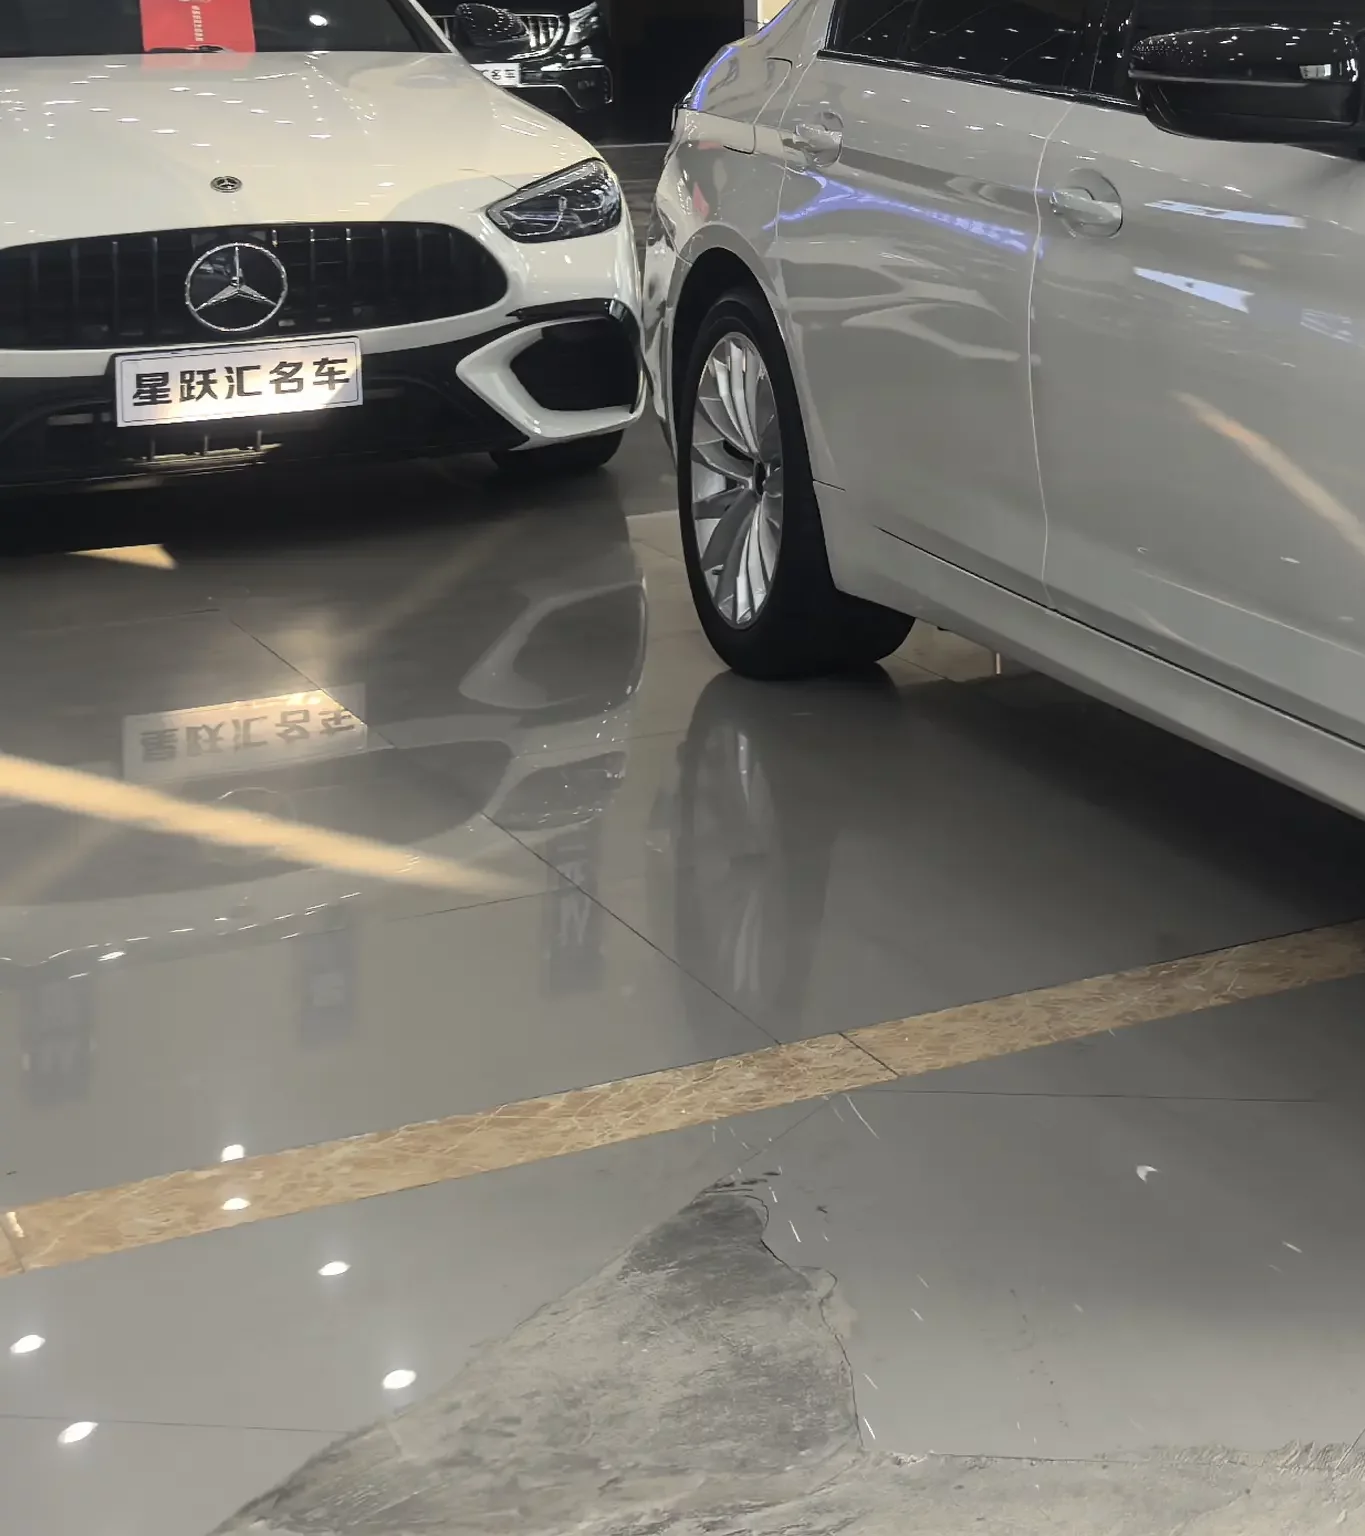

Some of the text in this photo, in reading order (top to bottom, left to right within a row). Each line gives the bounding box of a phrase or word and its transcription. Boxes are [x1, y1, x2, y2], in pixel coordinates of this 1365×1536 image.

[132, 356, 351, 407] 星跃汇名车
